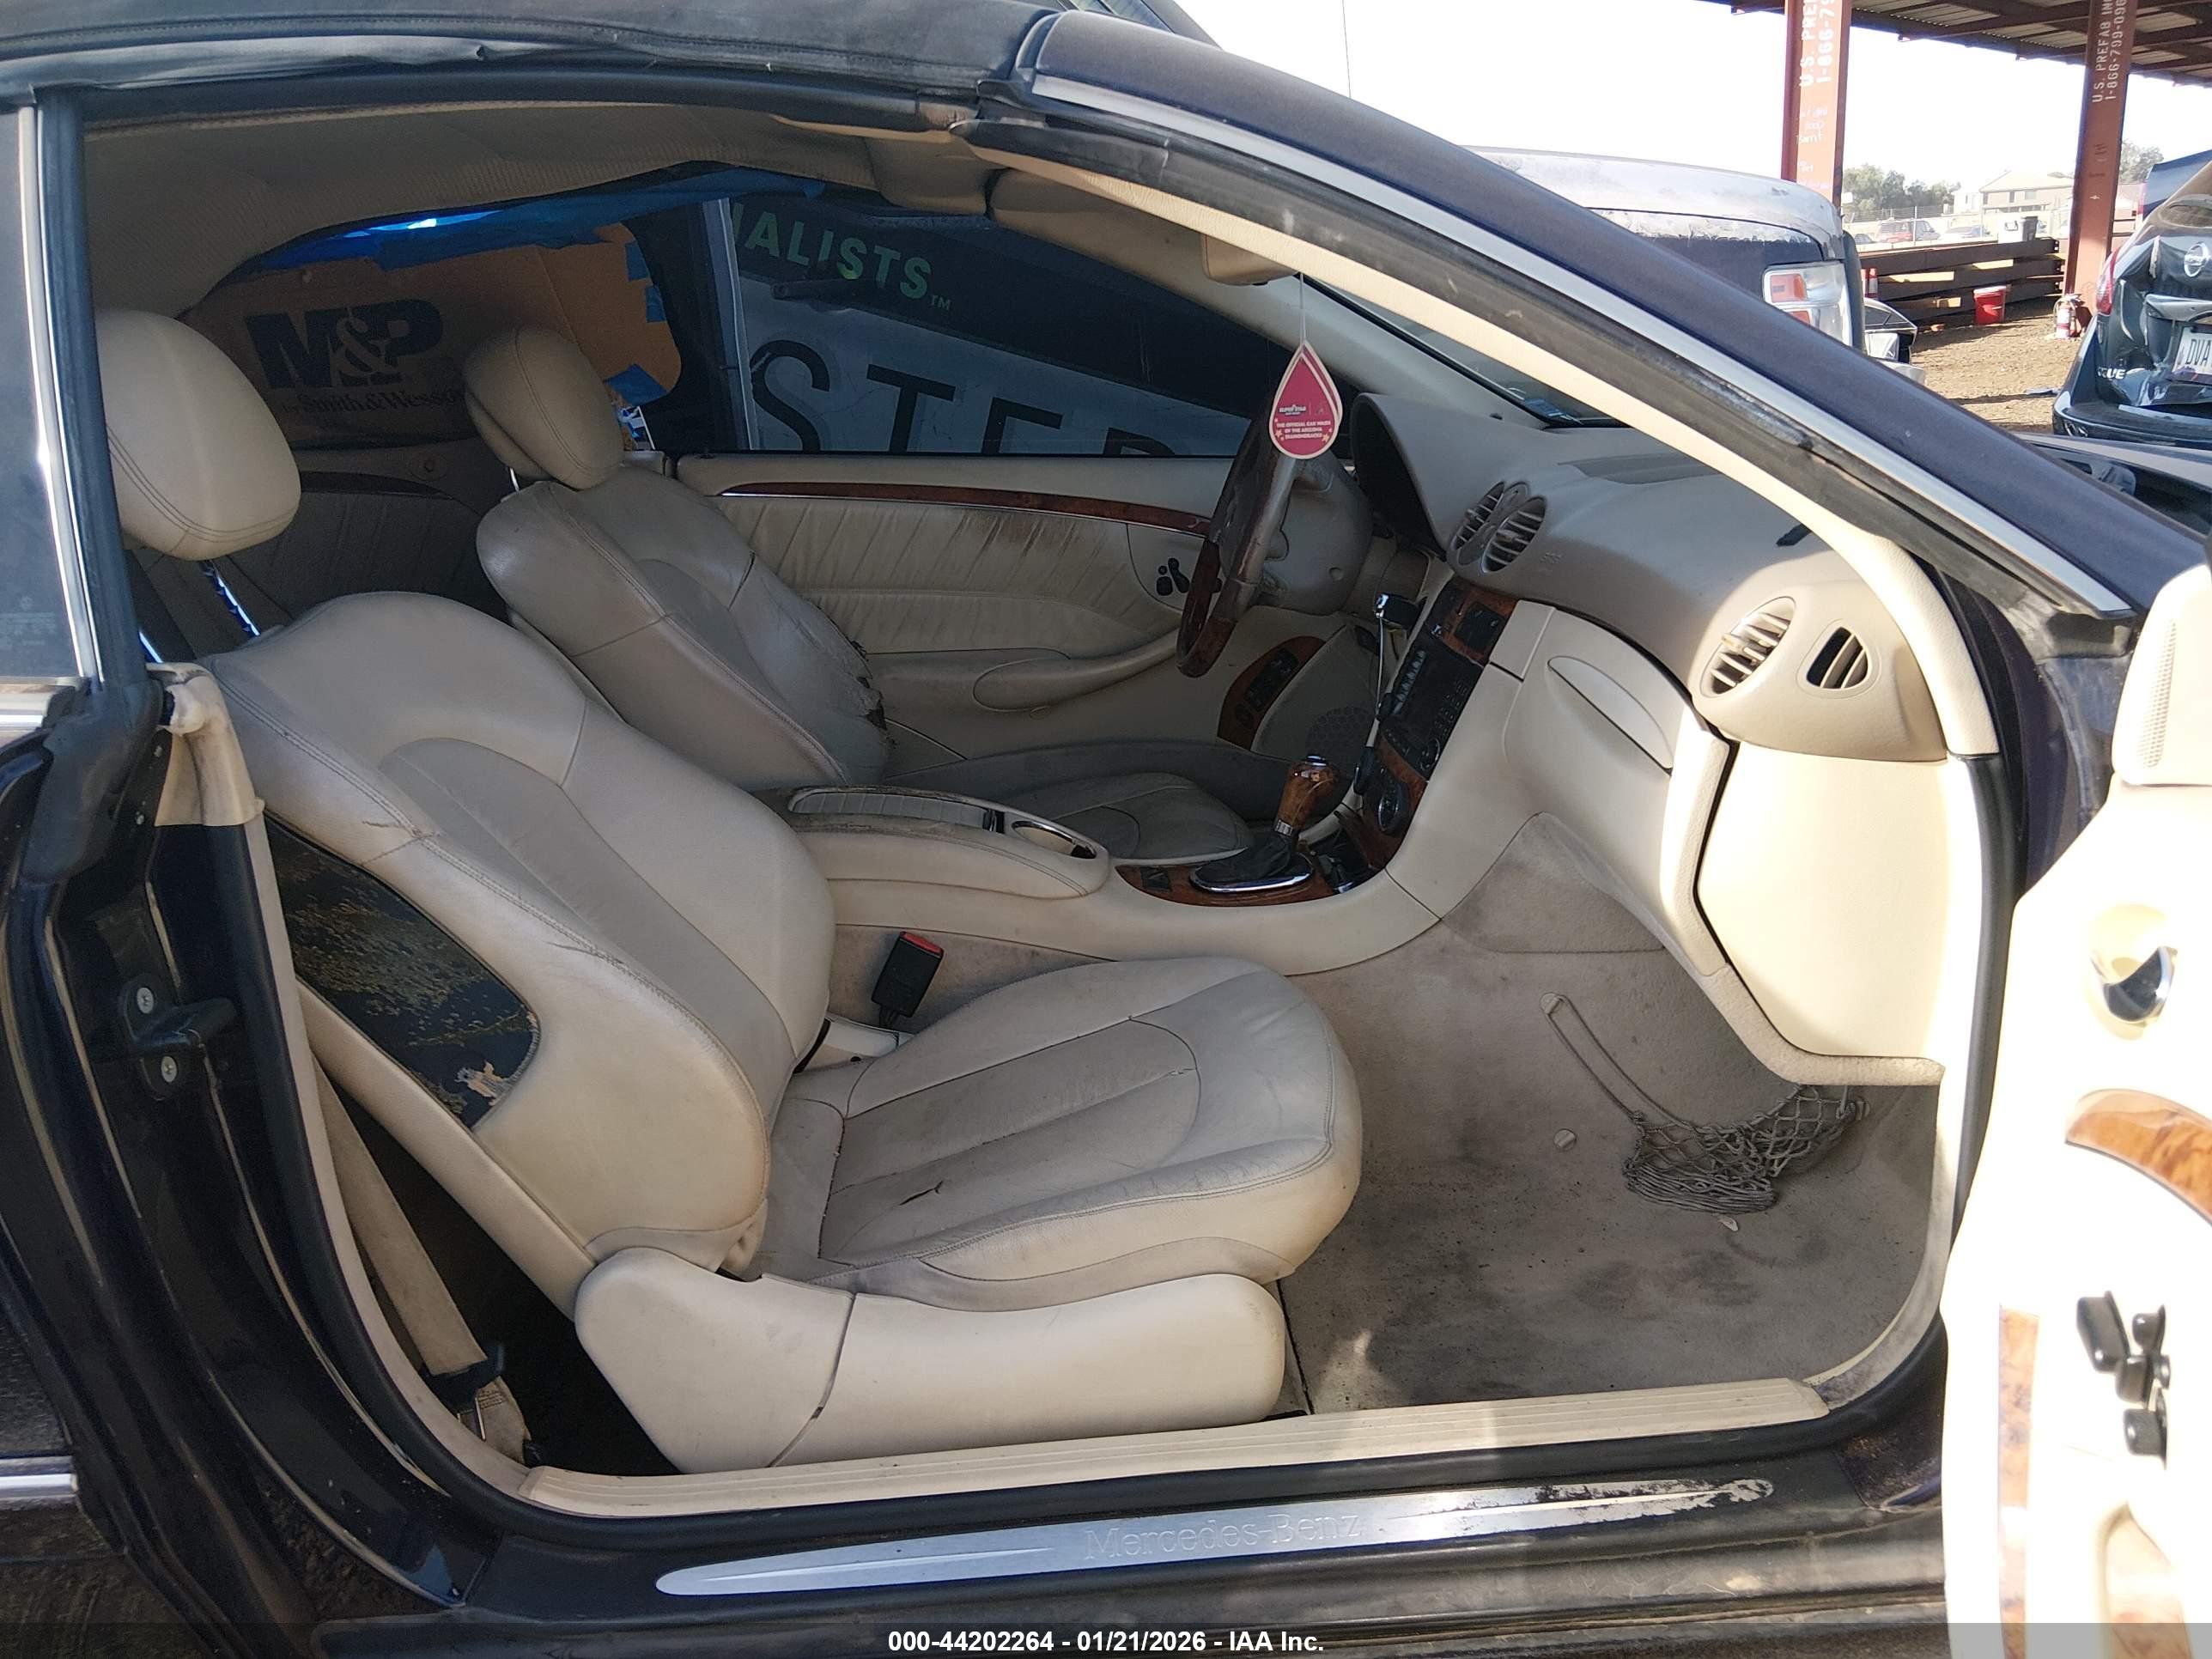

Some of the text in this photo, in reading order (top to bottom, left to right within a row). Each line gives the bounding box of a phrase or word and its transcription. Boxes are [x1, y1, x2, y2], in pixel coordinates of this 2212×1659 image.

[2092, 0, 2113, 103] U.S. PREFAB IN
[243, 299, 443, 387] M&P
[1083, 1514, 1363, 1559] Mercedes-Benz
